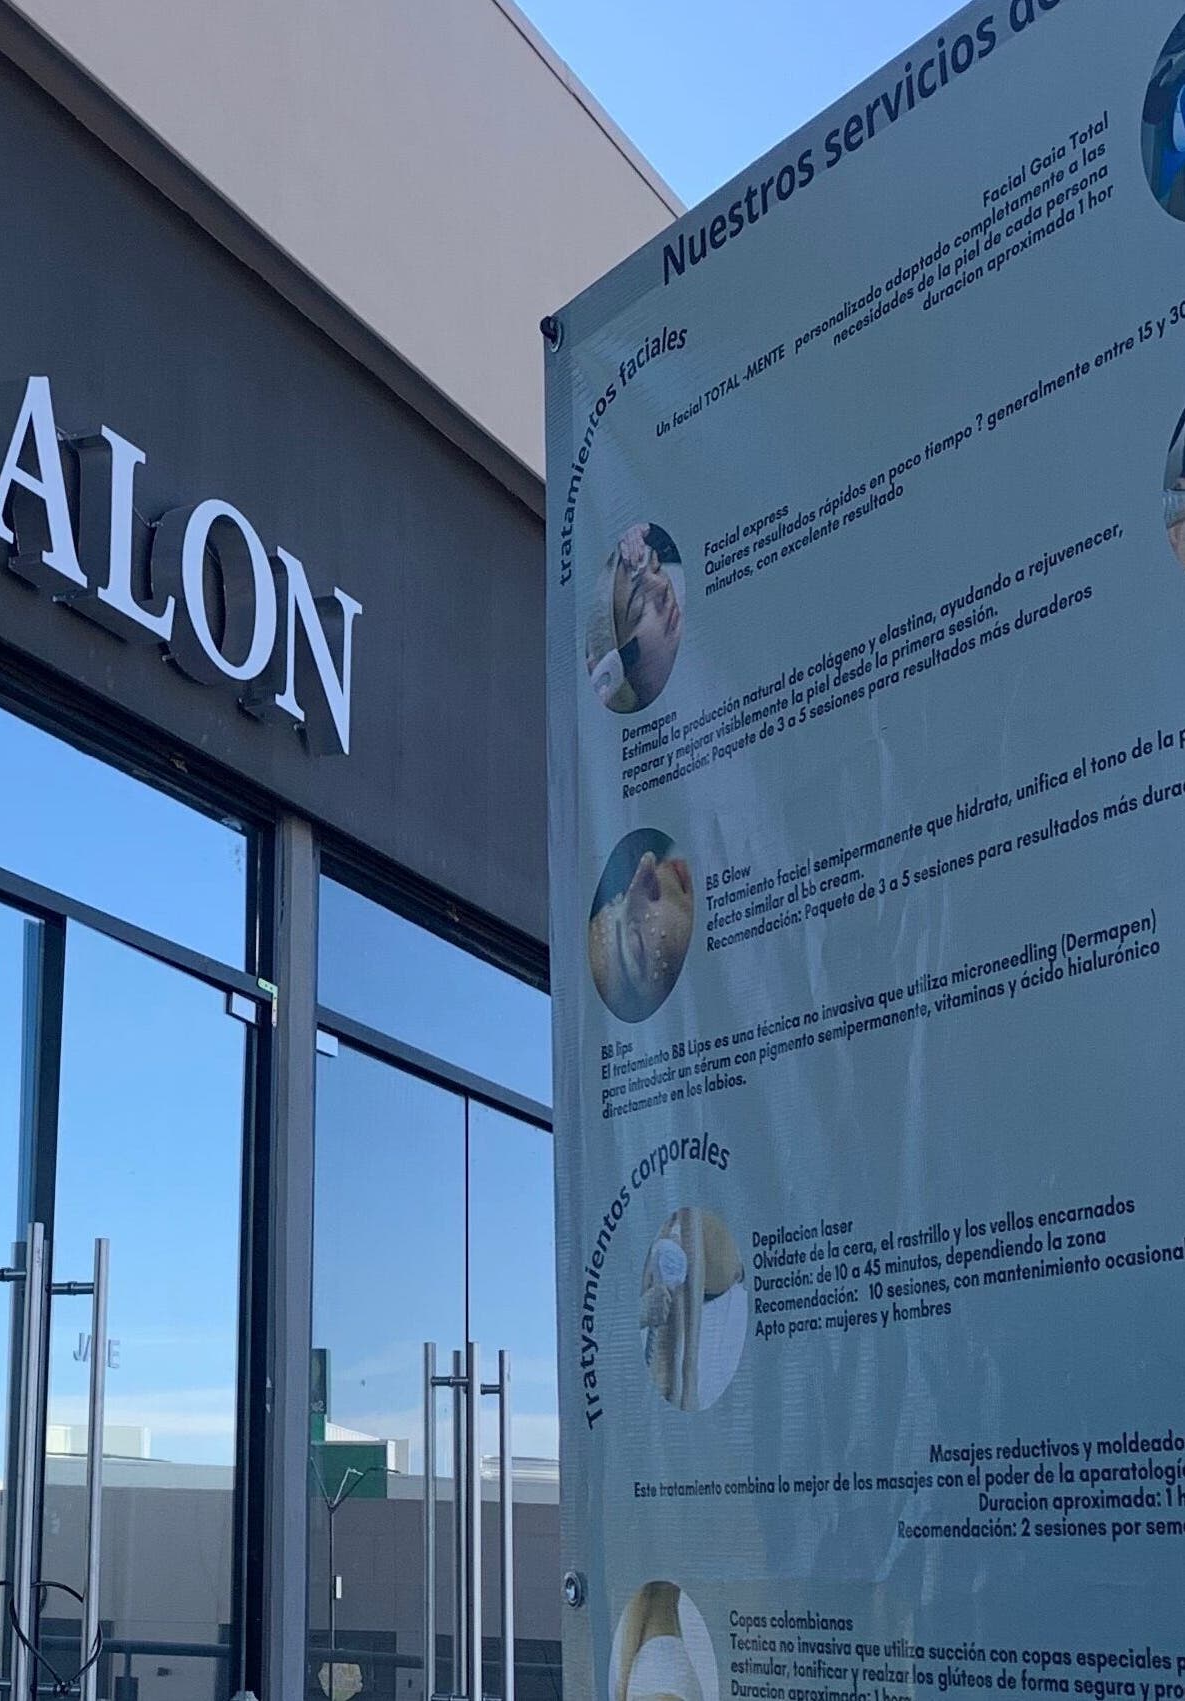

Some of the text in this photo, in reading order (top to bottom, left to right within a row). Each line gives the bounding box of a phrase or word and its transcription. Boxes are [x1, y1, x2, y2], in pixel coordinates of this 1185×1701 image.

[663, 149, 815, 286] Nuestros
[824, 15, 997, 168] servicios
[983, 110, 1108, 208] Facial Gaia Total
[833, 164, 1108, 346] necesidades piel cada persona
[923, 207, 1075, 310] duracion aproximada
[673, 170, 1065, 427] facial TOTAL -MENTE personalizado adaptado completamente
[560, 326, 688, 585] tratamientos faciales
[705, 336, 1135, 576] Quieres resultados rápidos poco tiempo generalmente entre
[704, 505, 791, 557] Facial express
[781, 482, 903, 557] excelente resultado
[622, 524, 1123, 762] Estimula natural colágeno ayudando rejuvenecer,
[712, 586, 1092, 762] Paquete sesiones resultados duraderos
[622, 604, 998, 781] reparar visiblemente piel desde primera sesión.
[622, 712, 677, 748] Dermapen
[706, 751, 1127, 911] Tratamiento facial semipermanente hidrata, unifica tono
[804, 809, 1099, 919] Paquete sesiones resultados
[707, 869, 864, 931] efecto similar cream.
[721, 865, 751, 885] Glow
[687, 909, 1157, 1058] Lips técnica invasiva utiliza microneedling (Dermapen)
[694, 940, 1160, 1074] sérum pigmento semipermanente, vitaminas ácido hialurónico
[705, 1070, 747, 1093] labios.
[753, 1195, 1135, 1270] Olvídate rastrillo vellos encarnados
[753, 1230, 1106, 1292] Duración: minutos, dependiendo zona
[821, 1218, 853, 1237] laser
[581, 1132, 731, 1430] Tratyamientos corporales
[886, 1254, 1101, 1300] sesiones, mantenimiento
[755, 1298, 951, 1341] Apto mujeres hombres
[633, 1463, 1030, 1498] Este combina mejor masajes poder
[929, 1431, 1185, 1466] Masajes reductivos moldeado
[979, 1491, 1049, 1511] Duracion
[1052, 1486, 1161, 1514] aproximada:
[1033, 1516, 1107, 1537] sesiones
[729, 1610, 853, 1633] Copas colombianas
[729, 1632, 777, 1652] Tecnica
[797, 1635, 852, 1656] invasiva
[883, 1638, 925, 1659] utiliza
[928, 1647, 986, 1663] succión
[1021, 1650, 1072, 1670] copas
[1076, 1647, 1172, 1672] especiales
[731, 1656, 1136, 1700] estimular, tonificar realzar glúteos forma segura
